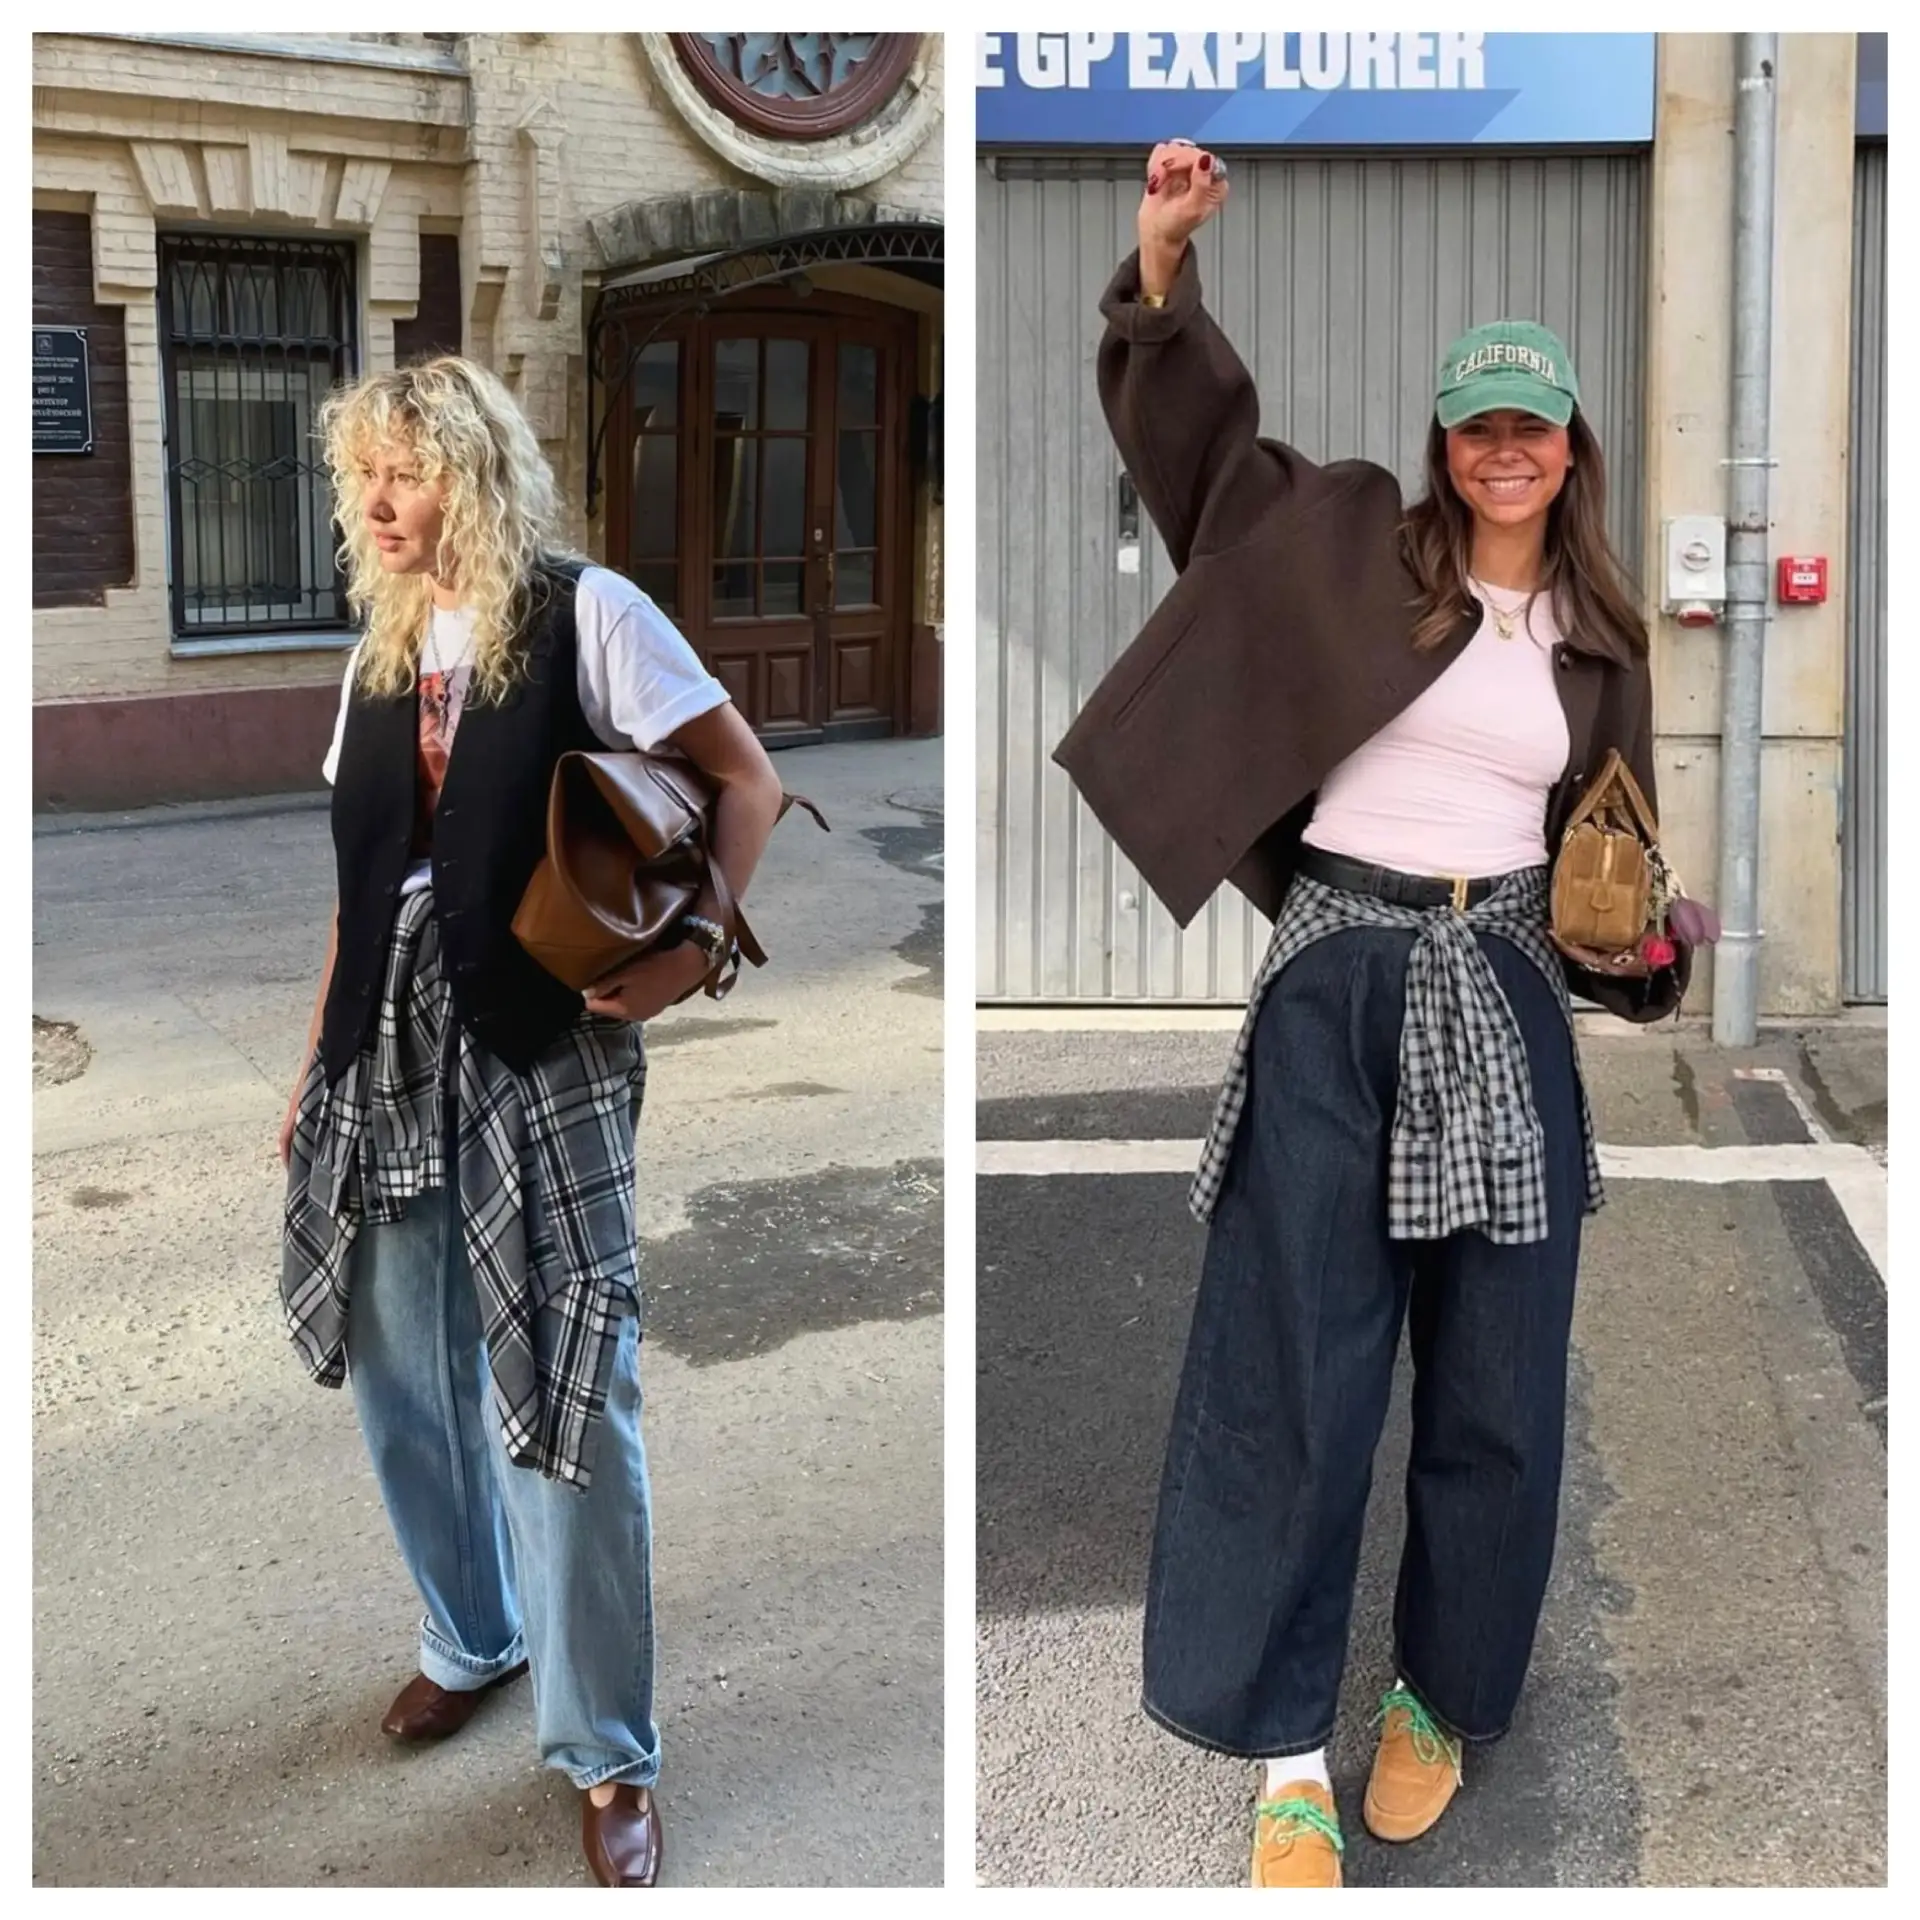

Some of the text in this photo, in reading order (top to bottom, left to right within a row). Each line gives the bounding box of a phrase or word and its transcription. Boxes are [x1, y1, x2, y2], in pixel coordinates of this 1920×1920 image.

[976, 32, 1485, 90] E GP EXPLORER
[1455, 343, 1558, 385] CALIFORNIA
